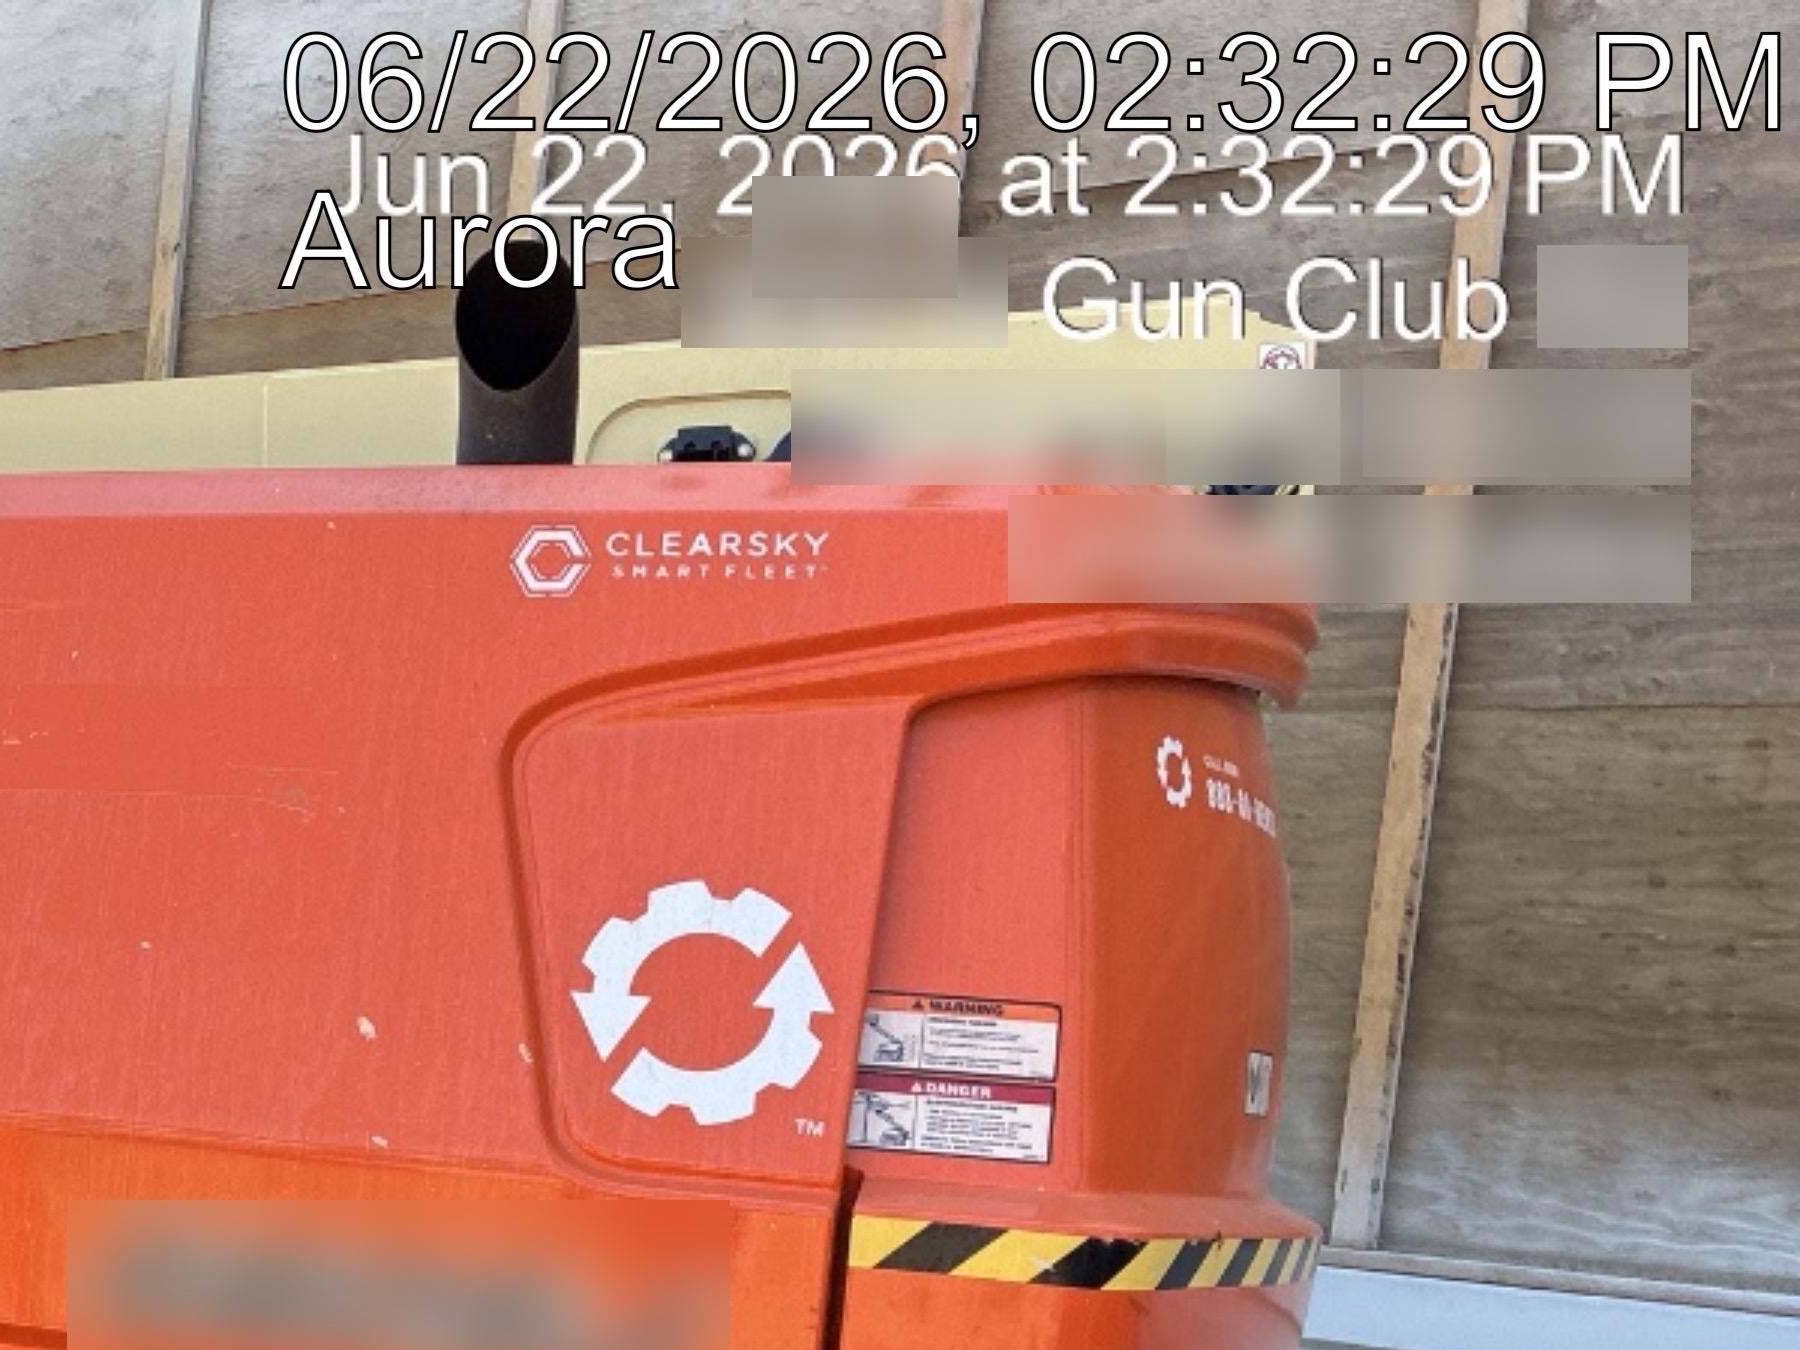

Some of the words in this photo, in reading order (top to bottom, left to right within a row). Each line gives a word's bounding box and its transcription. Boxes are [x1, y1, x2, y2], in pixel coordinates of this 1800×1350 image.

[605, 530, 829, 558] CLEARSKY
[611, 563, 711, 579] SMART
[724, 564, 818, 580] FLEET
[925, 1082, 992, 1098] DANGER
